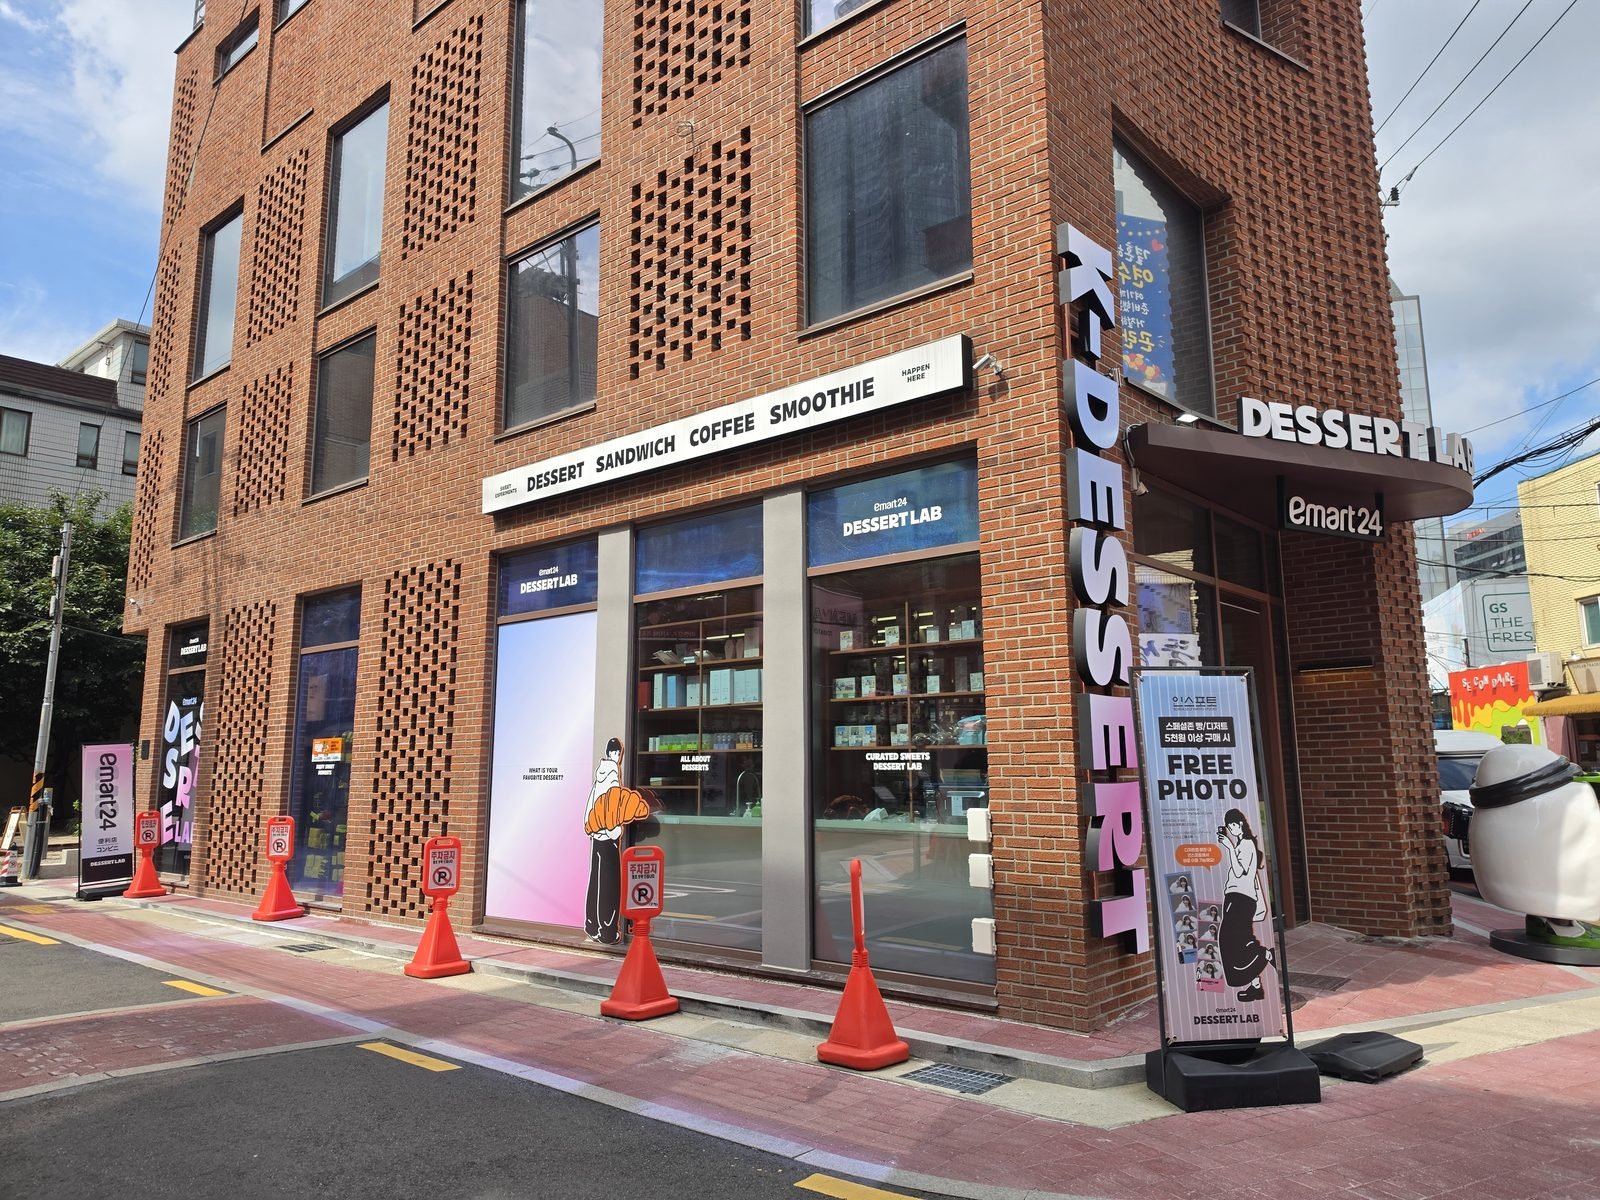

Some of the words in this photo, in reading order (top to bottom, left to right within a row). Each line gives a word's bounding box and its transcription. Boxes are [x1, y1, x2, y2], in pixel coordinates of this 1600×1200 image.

[901, 362, 931, 378] HAPPEN
[906, 372, 926, 384] HERE
[526, 461, 585, 493] DESSERT
[595, 434, 676, 474] SANDWICH
[689, 412, 755, 447] COFFEE
[769, 376, 875, 425] SMOOTHIE
[1240, 396, 1430, 462] DESSERT
[873, 496, 908, 513] emart24
[843, 511, 910, 538] DESSERT
[910, 505, 943, 526] LAB
[1288, 495, 1383, 538] emart24
[520, 577, 559, 595] DESSERT
[559, 573, 578, 587] LAB
[1060, 222, 1150, 956] K-DESSERT
[1489, 602, 1508, 614] GS
[1490, 616, 1524, 628] THE
[1164, 733, 1187, 743] 5천원
[1187, 733, 1203, 743] 이상
[1204, 733, 1221, 743] 구매
[1222, 733, 1231, 743] 시
[680, 755, 690, 763] ALL
[691, 755, 711, 763] ABOUT
[865, 752, 899, 761] CURATED
[900, 752, 931, 761] SWEETS
[681, 763, 709, 772] DESSERTS
[873, 762, 905, 771] DESSERT
[906, 762, 922, 771] LAB
[1167, 754, 1234, 775] FREE
[542, 773, 564, 781] DESSERT?
[99, 752, 118, 831] emart24
[1157, 778, 1248, 801] PHOTO
[431, 849, 456, 861] 주차금지
[89, 859, 114, 867] DESSERT
[629, 862, 658, 876] 주차금지
[1193, 1014, 1238, 1025] DESSERT
[1239, 1013, 1260, 1023] LAB
